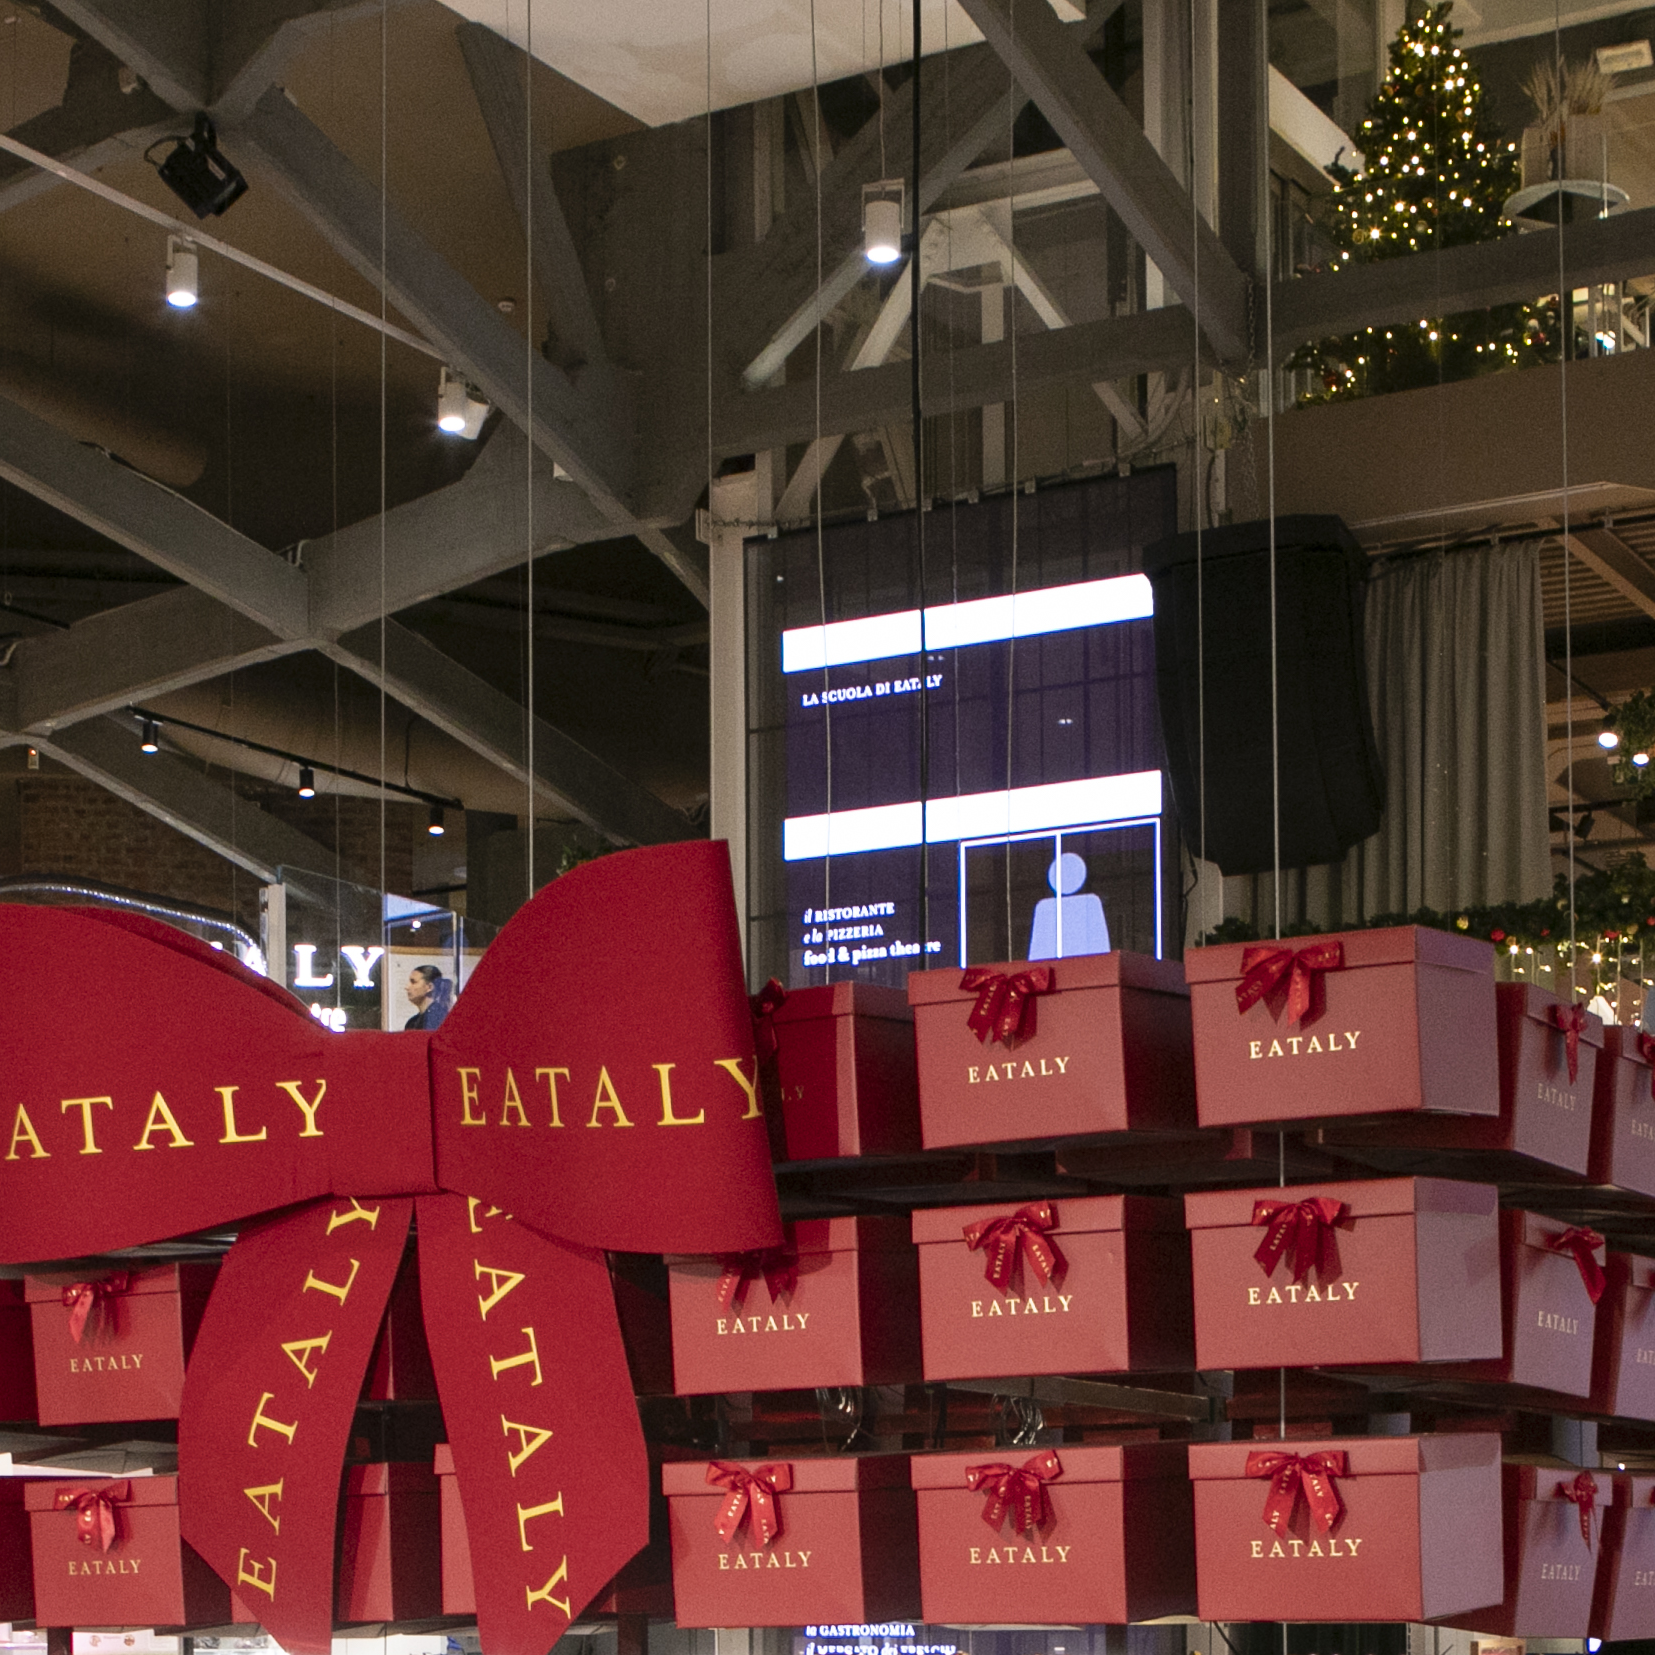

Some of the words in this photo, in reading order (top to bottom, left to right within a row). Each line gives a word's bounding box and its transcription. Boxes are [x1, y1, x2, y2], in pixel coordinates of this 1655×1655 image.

[802, 692, 819, 708] LA
[821, 685, 873, 705] SCUOLA
[875, 681, 891, 696] DI
[803, 908, 812, 924] il
[814, 902, 896, 923] RISTORANTE
[802, 933, 811, 945] e
[811, 928, 823, 944] la
[826, 924, 884, 942] PIZZERIA
[803, 947, 835, 967] food
[837, 945, 850, 963] &
[851, 944, 888, 966] pizza
[889, 940, 941, 957] theare
[1249, 1031, 1361, 1060] EATALY
[968, 1056, 1070, 1084] EATALY
[457, 1055, 763, 1128] EATALY
[1248, 1281, 1360, 1306] EATALY
[971, 1294, 1074, 1318] EATALY
[716, 1313, 810, 1335] EATALY
[1537, 1311, 1579, 1335] EATALY
[70, 1353, 144, 1373] EATALY
[238, 1196, 381, 1602] EATALY
[969, 1545, 1072, 1564] EATALY
[1250, 1538, 1364, 1558] EATALY
[68, 1559, 142, 1576] EATALY
[718, 1550, 813, 1570] EATALY
[819, 1624, 915, 1637] GASTRONOMIA
